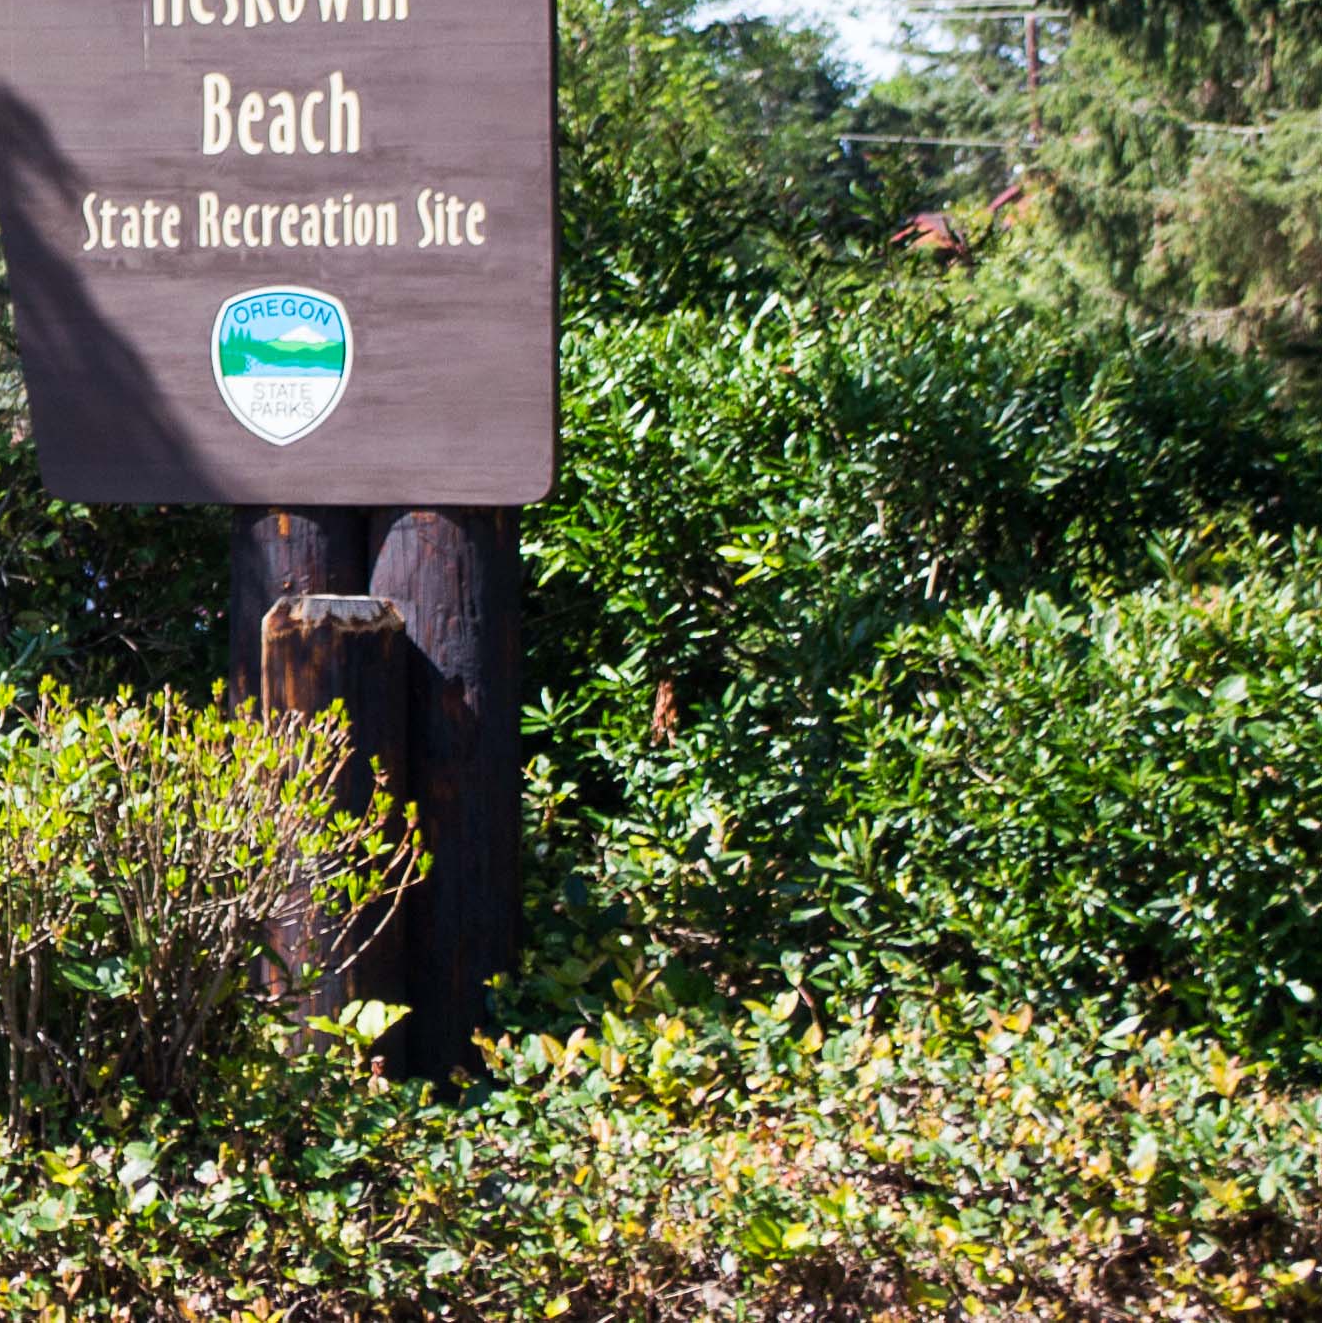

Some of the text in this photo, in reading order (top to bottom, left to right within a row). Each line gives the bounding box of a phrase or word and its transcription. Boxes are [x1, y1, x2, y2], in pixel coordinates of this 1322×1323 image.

[201, 71, 361, 155] Beach
[82, 187, 487, 251] State Recreation Site
[233, 298, 332, 326] OREGON
[252, 382, 312, 400] STATE
[250, 401, 315, 419] PARKS
